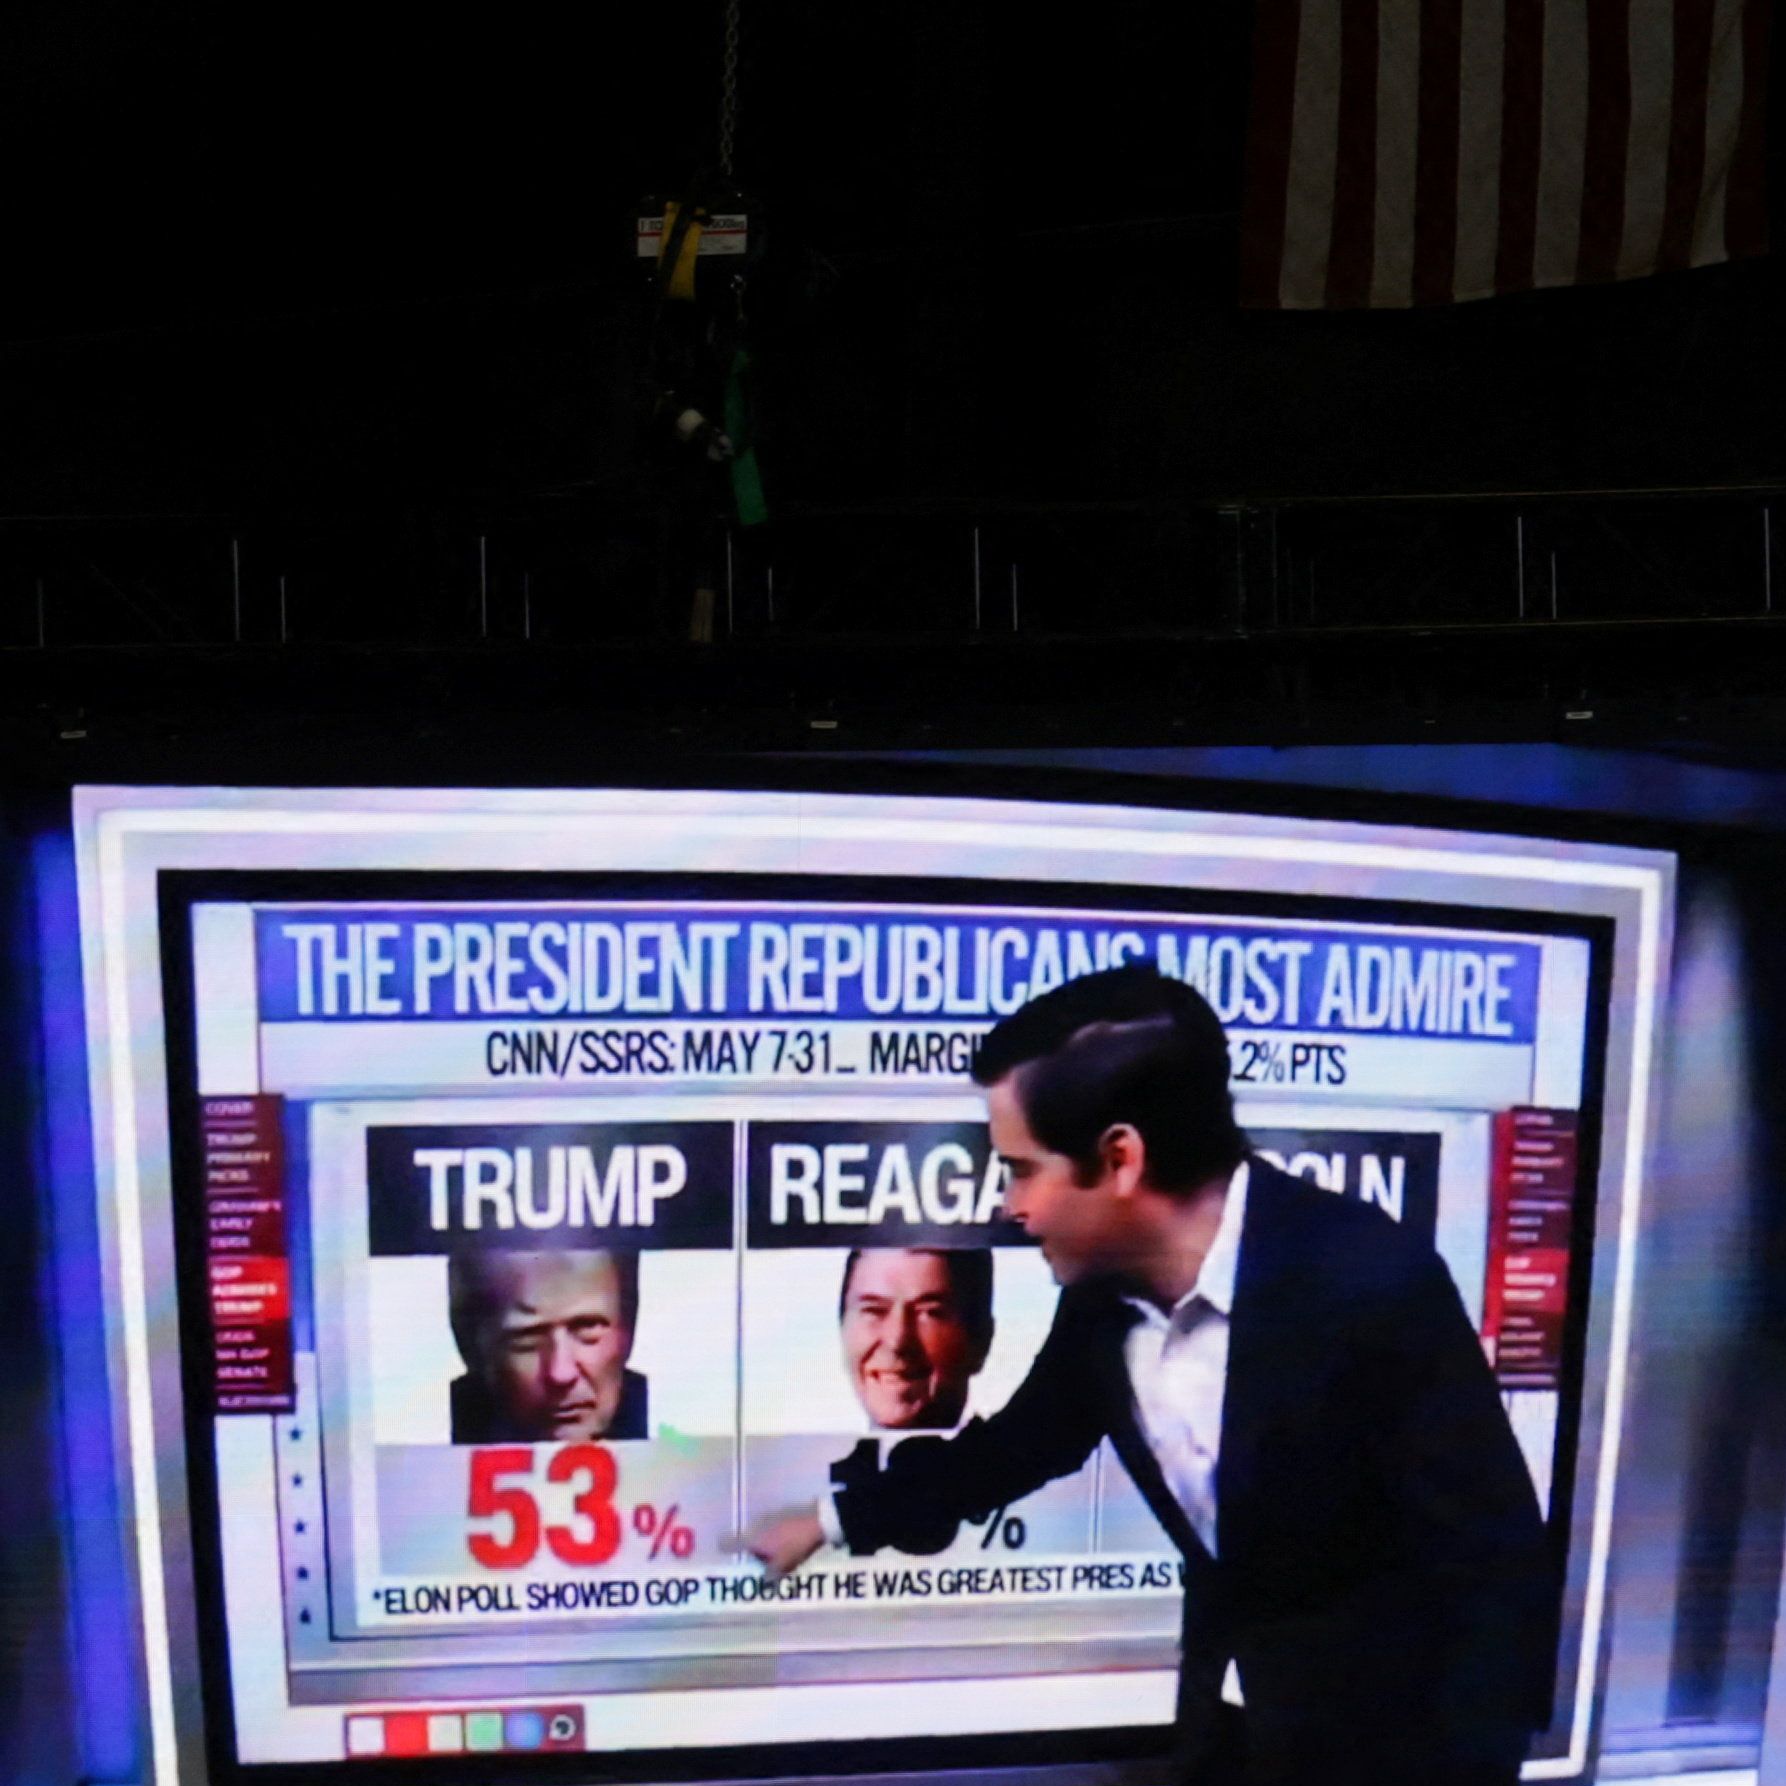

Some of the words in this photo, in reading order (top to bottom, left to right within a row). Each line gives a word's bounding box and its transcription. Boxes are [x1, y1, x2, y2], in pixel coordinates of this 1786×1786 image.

[282, 922, 402, 1016] THE
[413, 920, 741, 1016] PRESIDENT
[1316, 942, 1518, 1037] ADMIRE
[486, 1030, 676, 1079] CNN/SSRS:
[683, 1031, 761, 1075] MAY
[870, 1032, 982, 1075] MARGI
[1291, 1042, 1346, 1086] PTS
[413, 1144, 688, 1231] TRUMP
[770, 1143, 1014, 1226] REAGA
[467, 1442, 695, 1570] 53%
[457, 1583, 521, 1613] POLL
[526, 1579, 640, 1611] SHOWED
[645, 1577, 701, 1607] GOP
[706, 1572, 826, 1602] THOUGHT
[834, 1570, 867, 1599] HE
[873, 1567, 933, 1598] WAS
[938, 1563, 1065, 1596] GREATEST
[1071, 1561, 1134, 1592] PRES
[1140, 1560, 1174, 1589] AS
